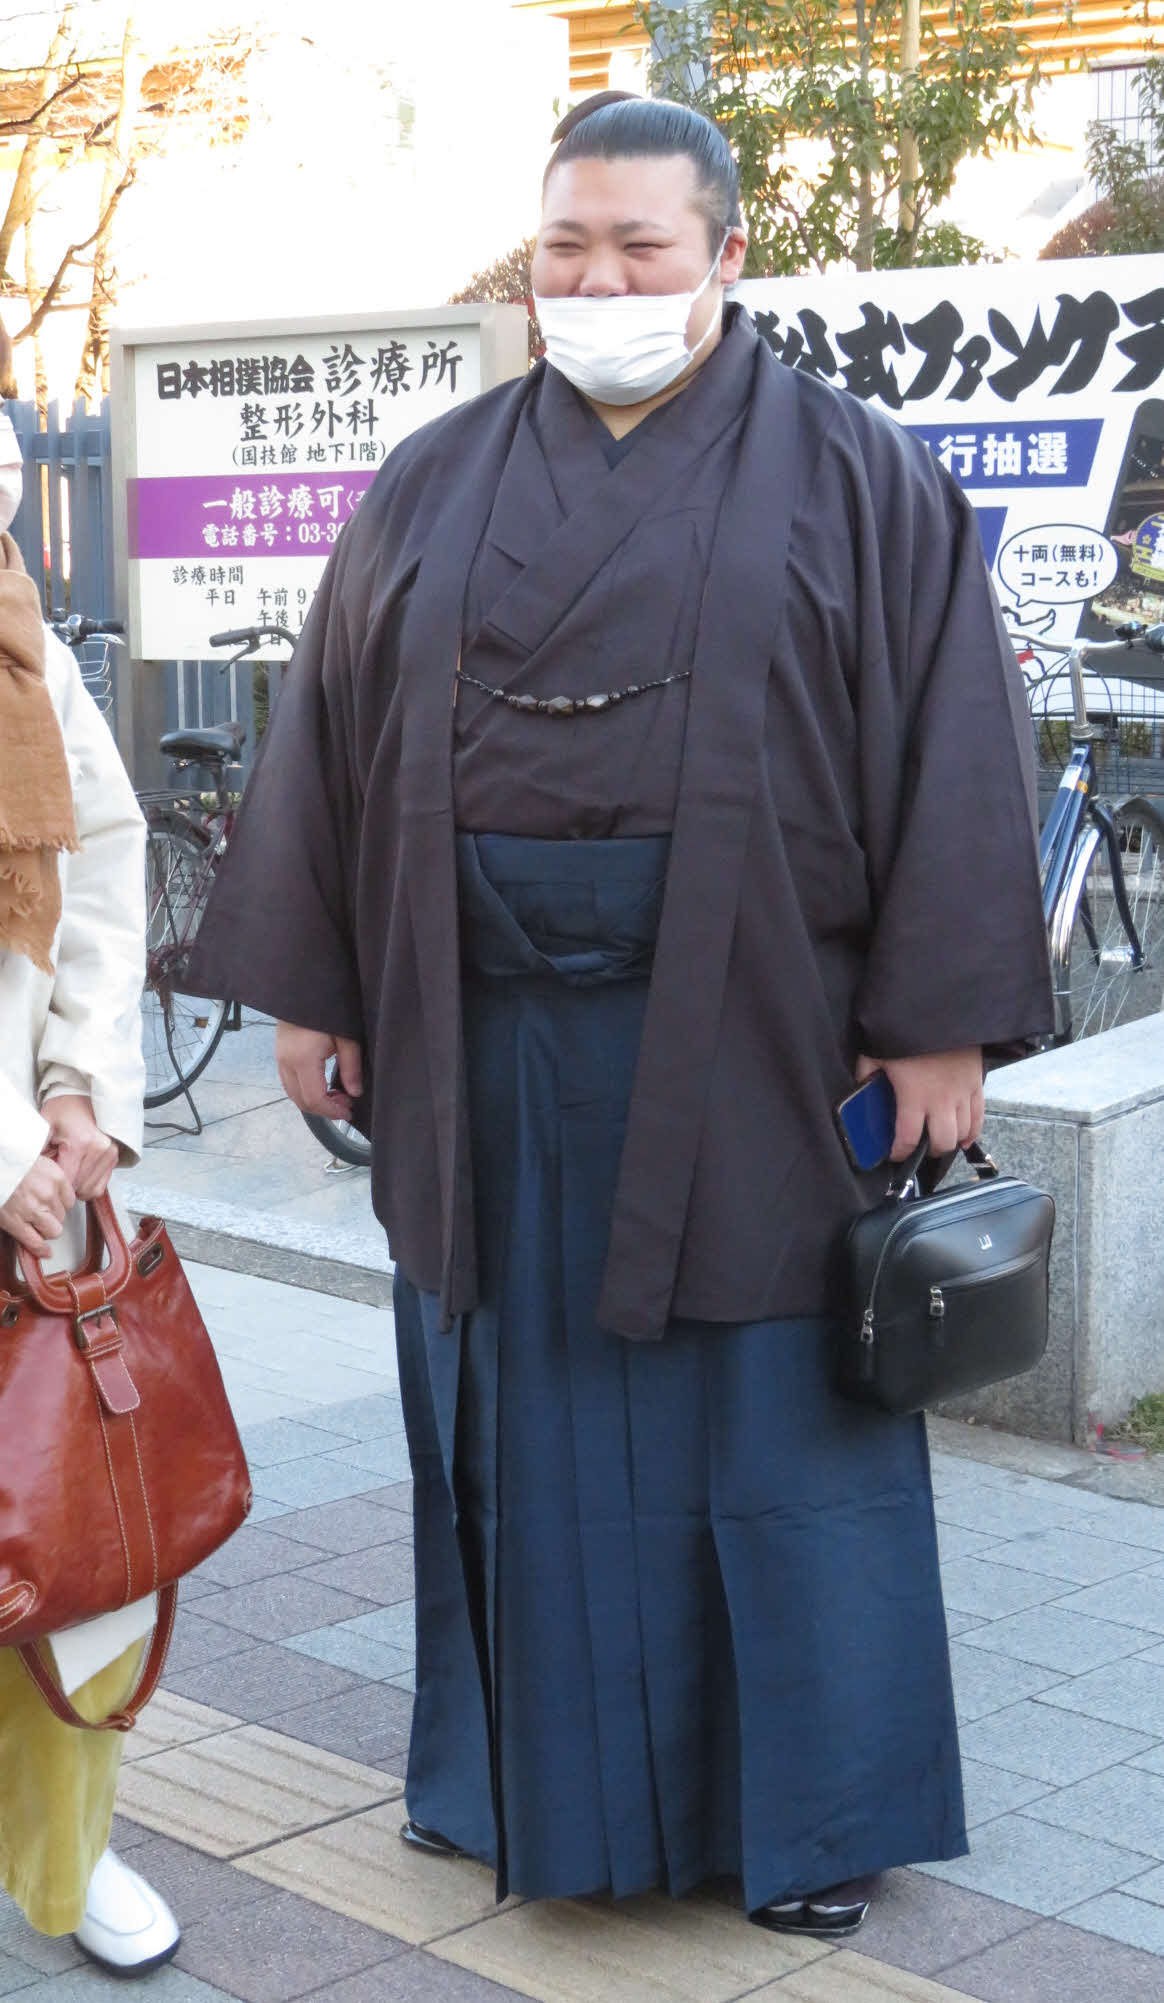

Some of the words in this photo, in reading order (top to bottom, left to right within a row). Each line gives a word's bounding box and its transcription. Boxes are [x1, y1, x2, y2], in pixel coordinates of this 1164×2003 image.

[240, 398, 379, 442] 整形外科
[923, 431, 1068, 477] 行抽選
[1013, 544, 1104, 563] 十両(無料)
[172, 565, 244, 585] 診療時間
[1021, 570, 1097, 588] コースも!
[205, 588, 236, 606] 平日
